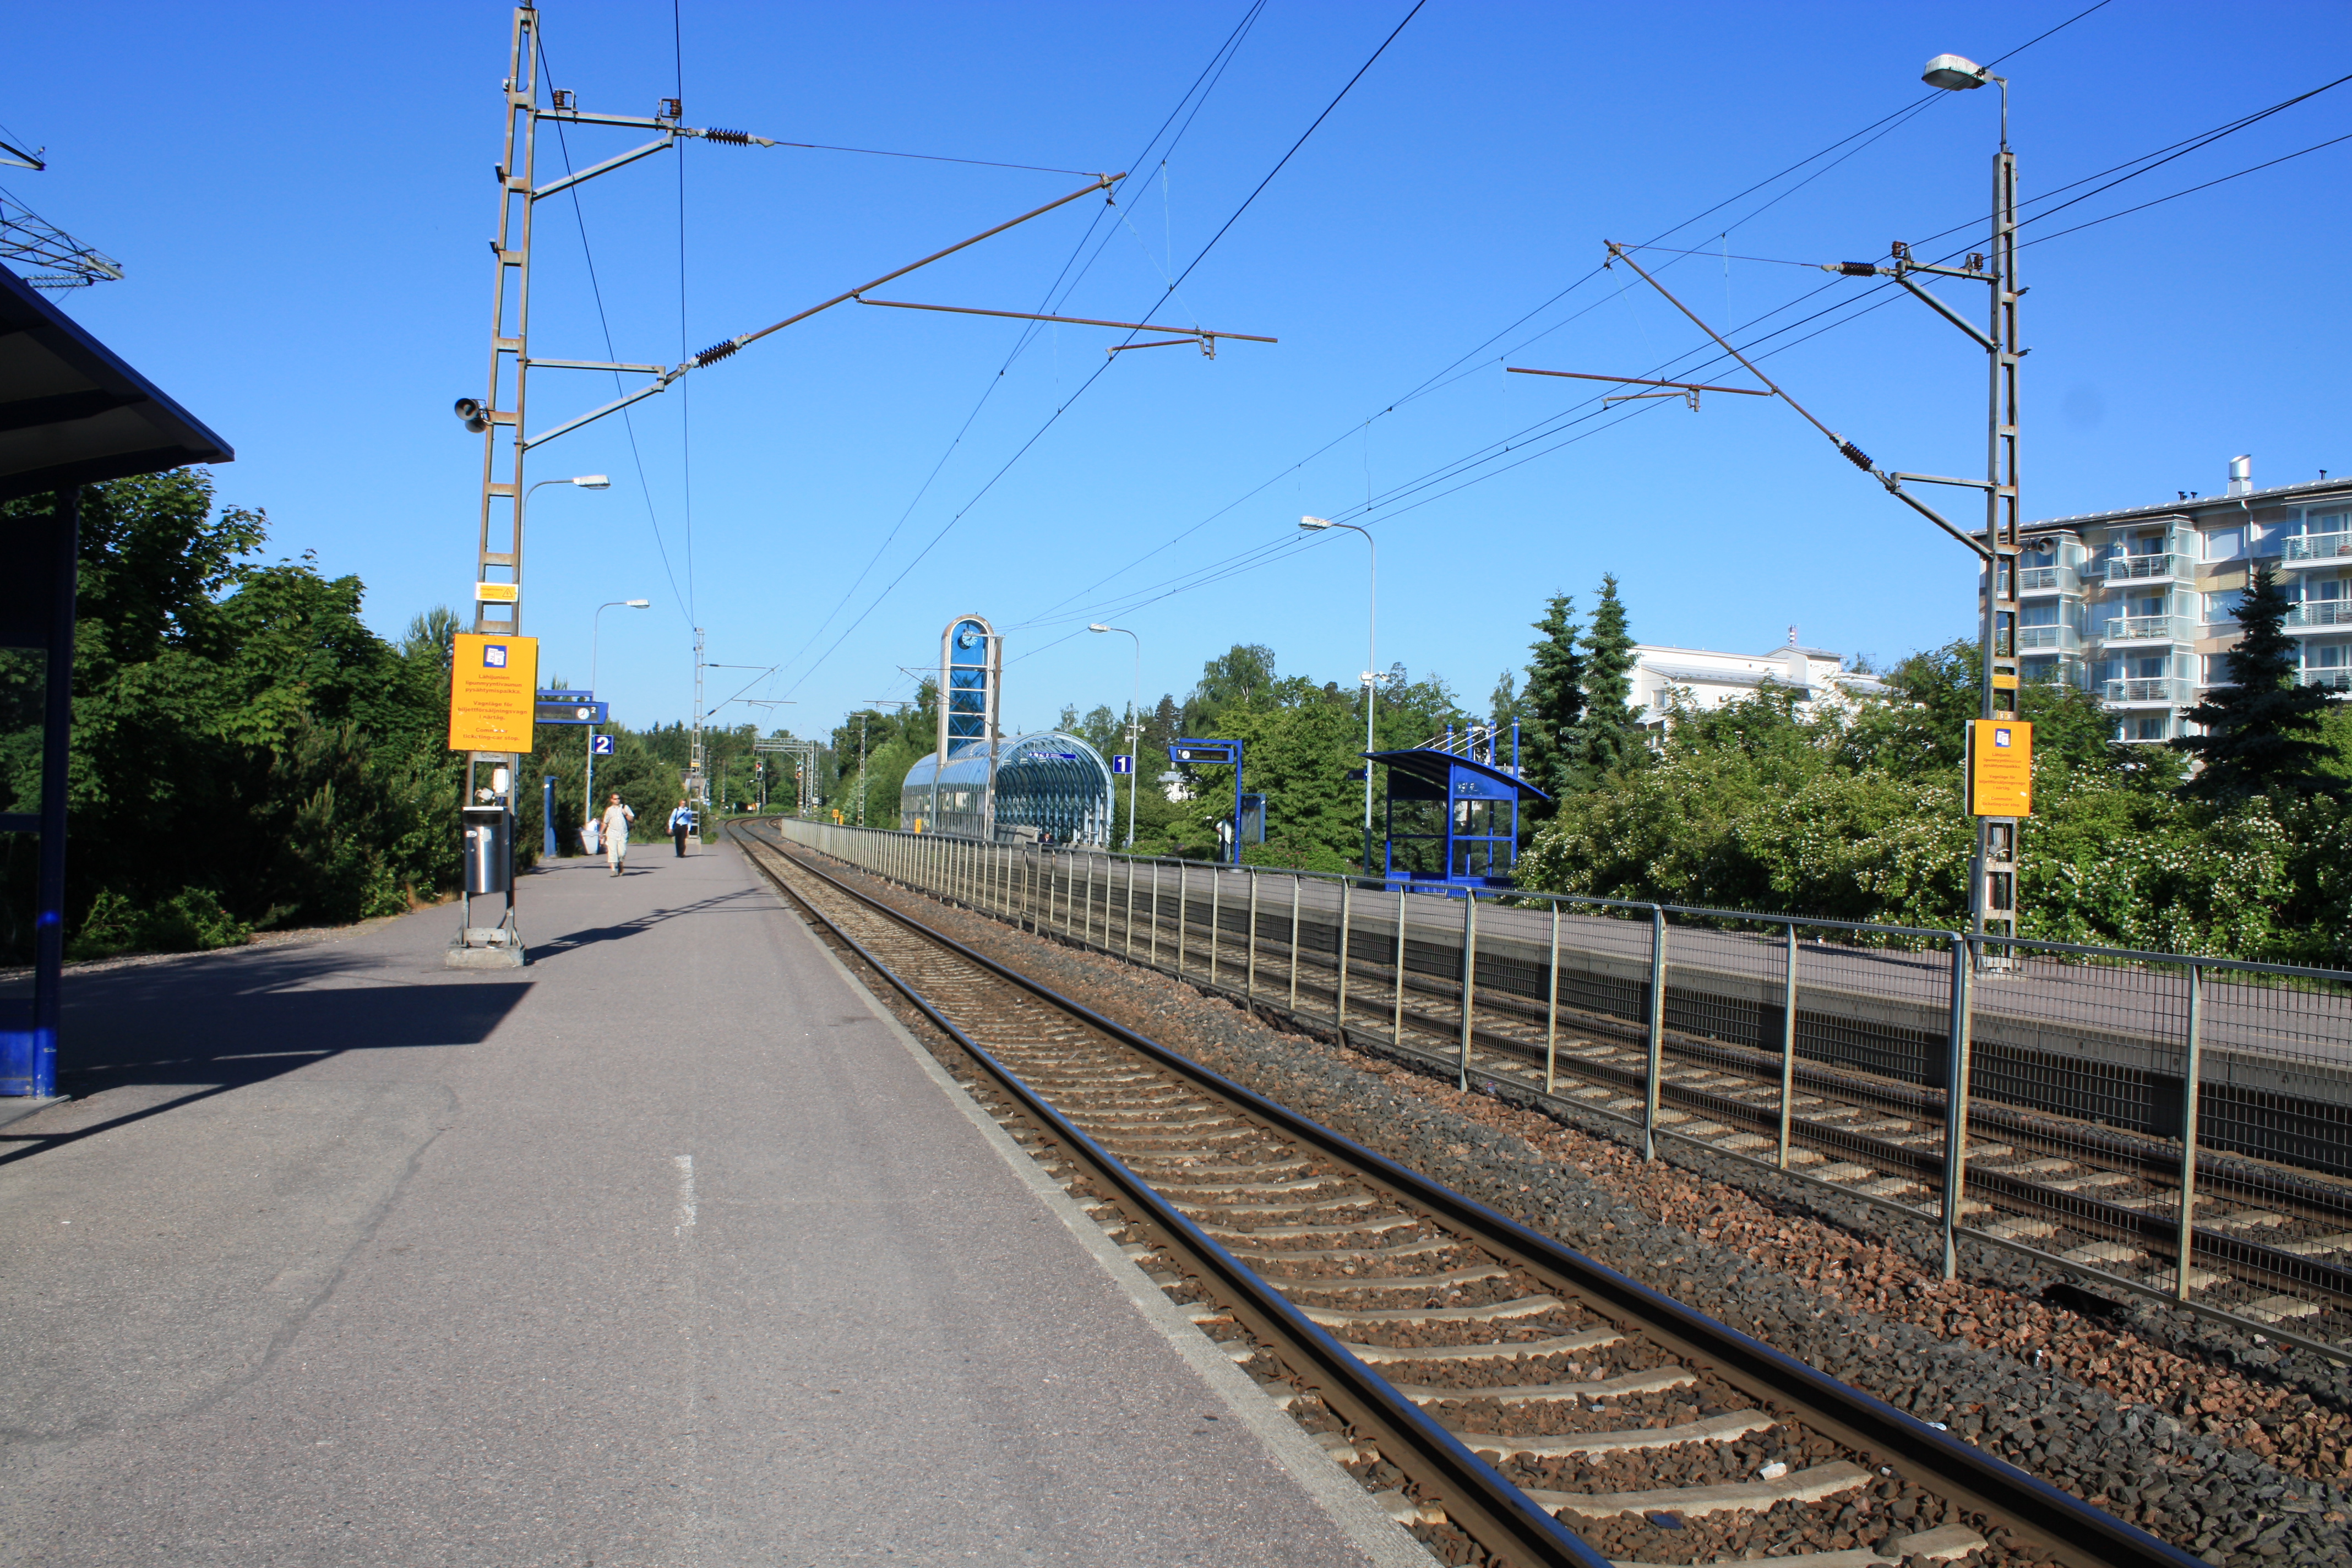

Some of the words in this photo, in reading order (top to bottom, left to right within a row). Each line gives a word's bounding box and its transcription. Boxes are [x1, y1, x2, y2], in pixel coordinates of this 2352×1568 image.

[458, 706, 527, 715] biljettförsäljningsvagn
[596, 736, 609, 753] 2
[1118, 757, 1126, 772] 1
